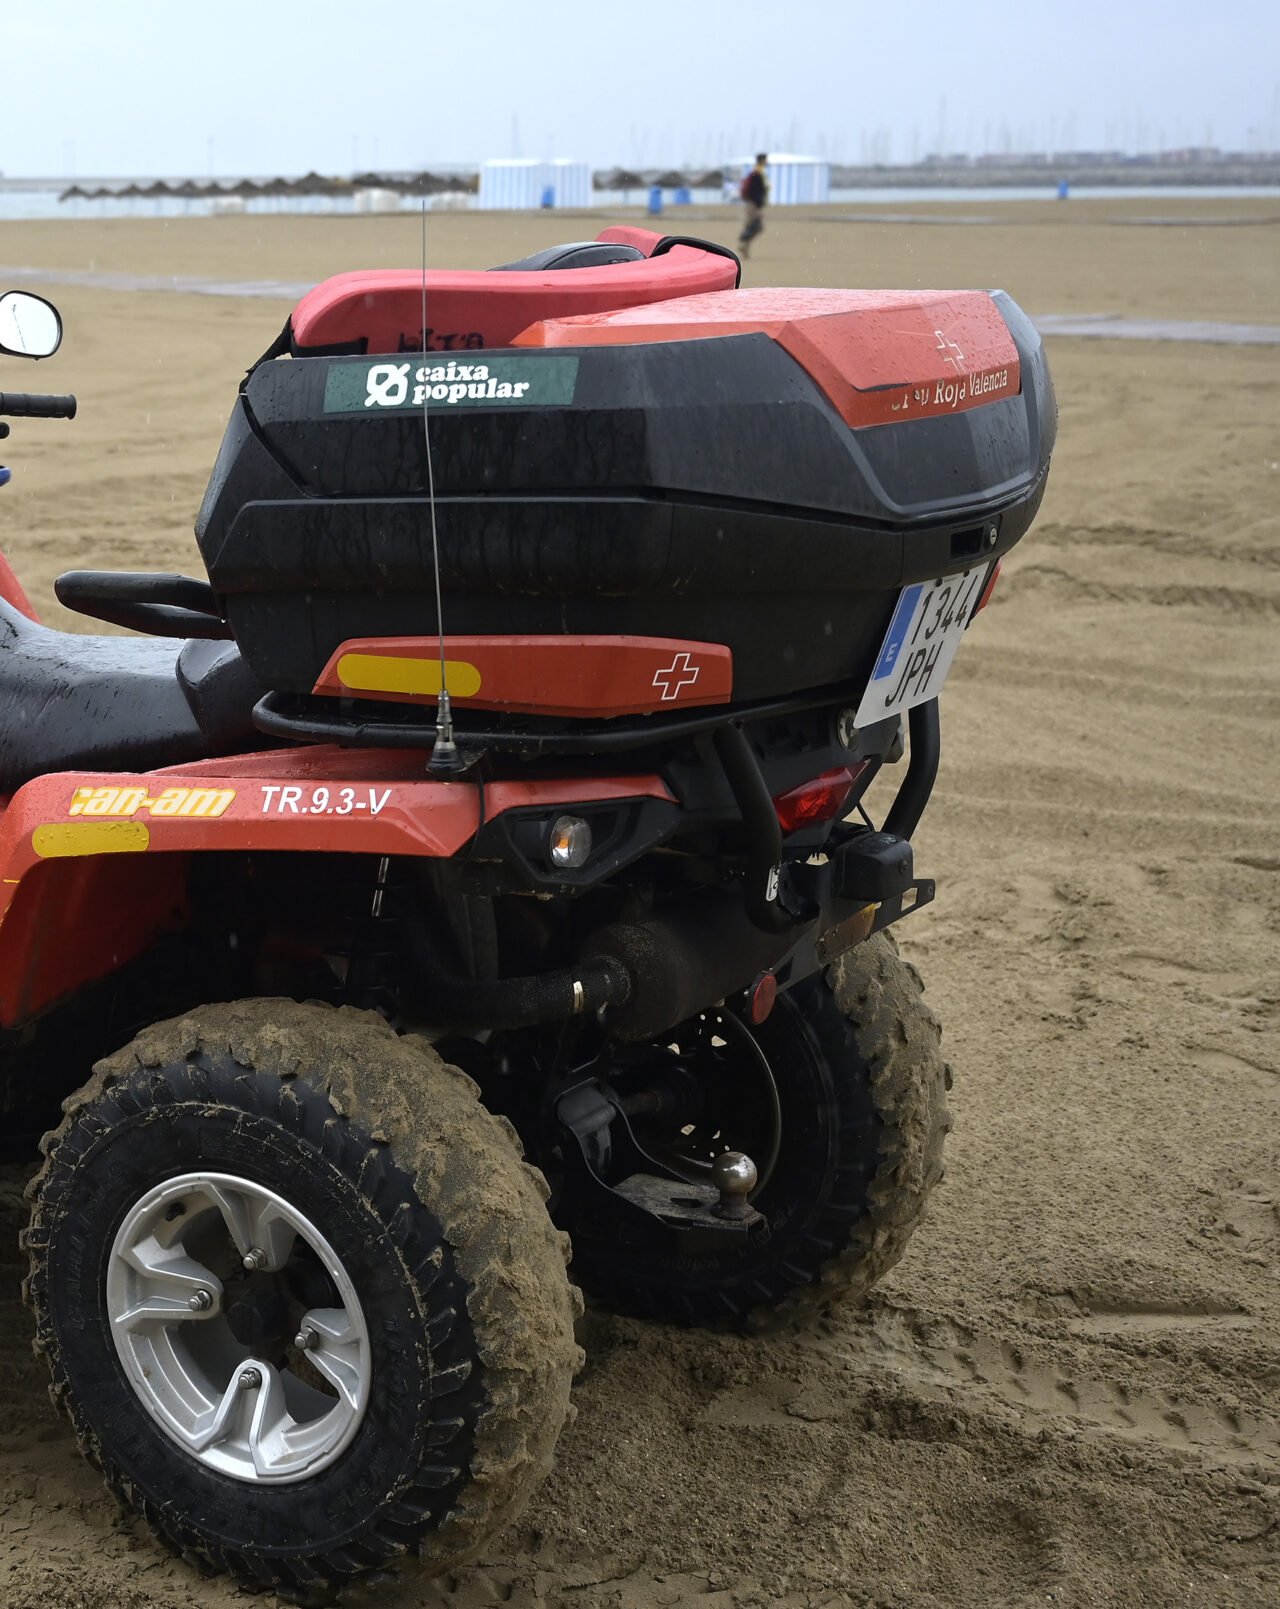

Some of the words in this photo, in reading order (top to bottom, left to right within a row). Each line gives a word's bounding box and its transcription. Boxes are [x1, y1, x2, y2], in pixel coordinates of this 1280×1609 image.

[415, 361, 490, 382] caixa
[969, 369, 1008, 397] Valencia
[412, 378, 530, 405] popular
[911, 574, 979, 646] 1344
[885, 643, 898, 663] E
[884, 641, 944, 708] JPH
[69, 787, 237, 816] can-am
[260, 786, 393, 815] TR.9.3-V
